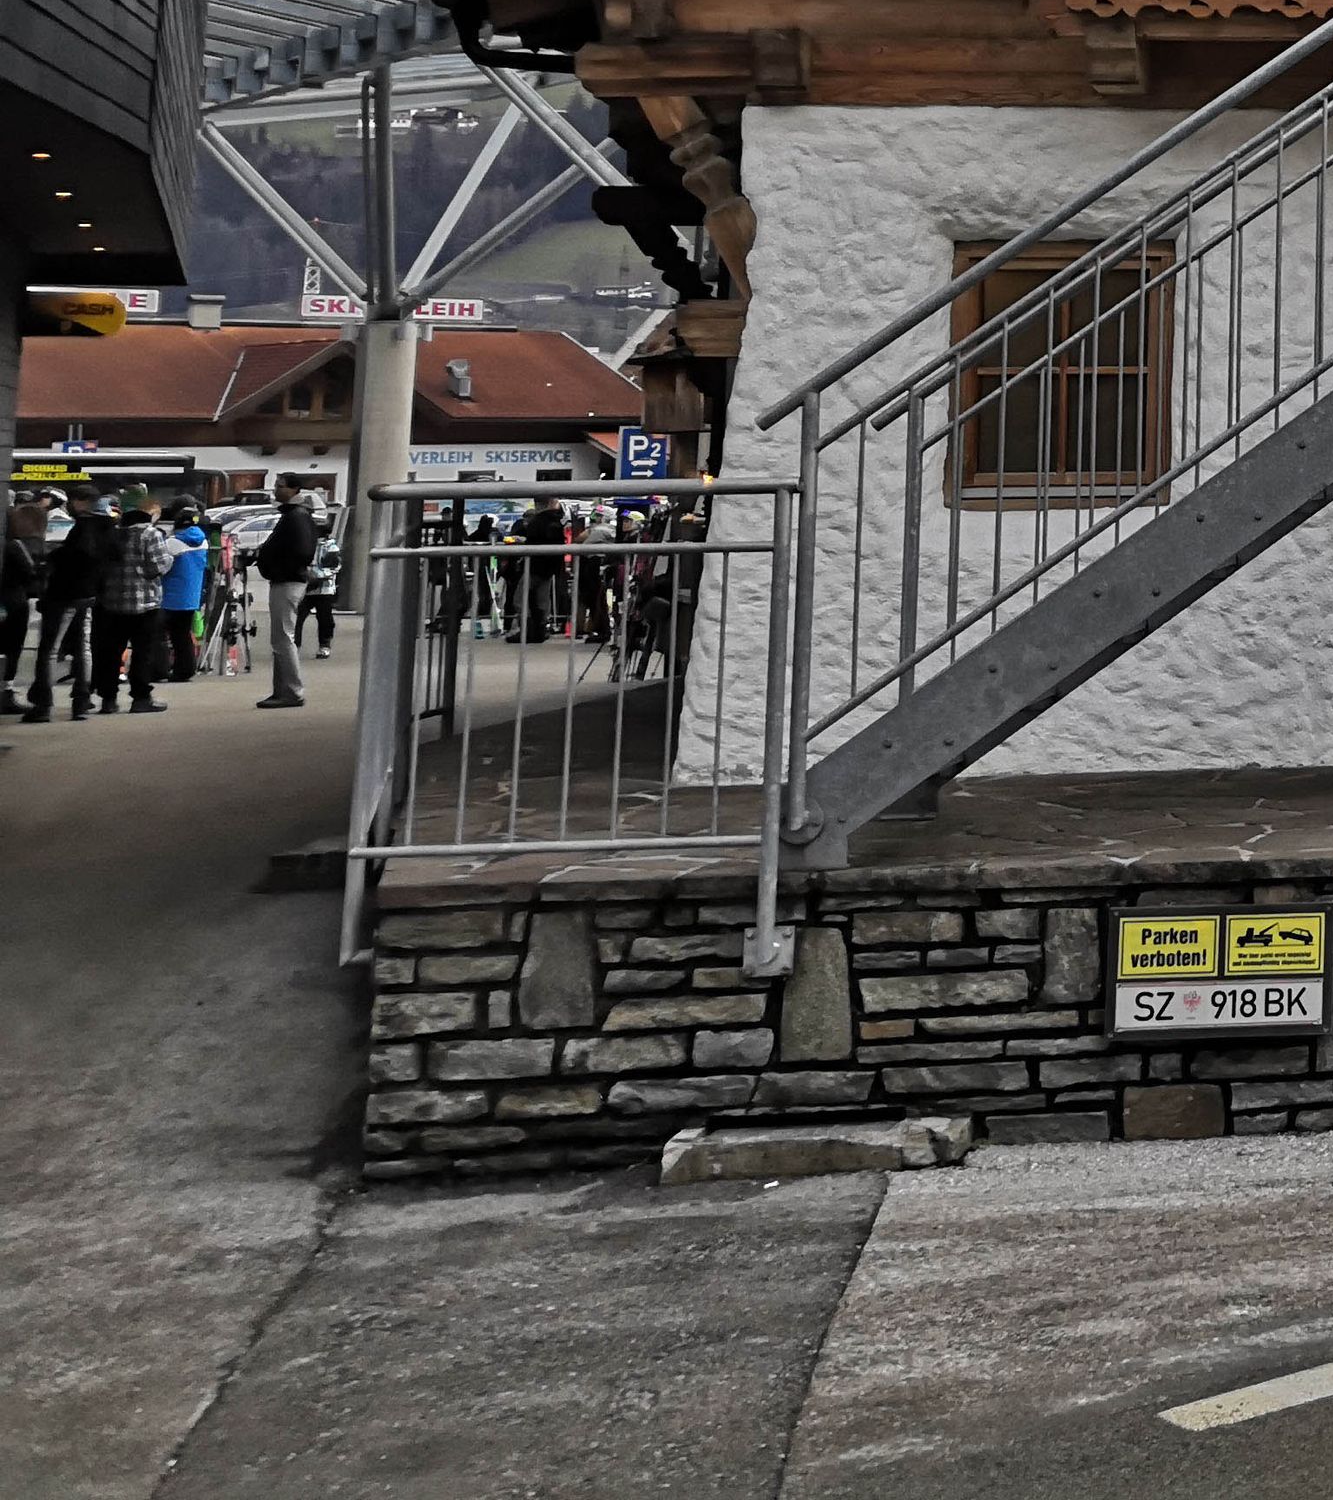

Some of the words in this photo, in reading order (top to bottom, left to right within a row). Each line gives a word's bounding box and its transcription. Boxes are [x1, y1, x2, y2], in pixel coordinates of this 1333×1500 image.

[409, 451, 473, 464] VERLEIH
[485, 450, 571, 463] SKISERVICE
[1141, 927, 1198, 945] Parken
[1131, 949, 1207, 968] verboten!
[1134, 991, 1175, 1021] SZ
[1210, 989, 1257, 1019] 918
[1264, 987, 1308, 1017] BK
